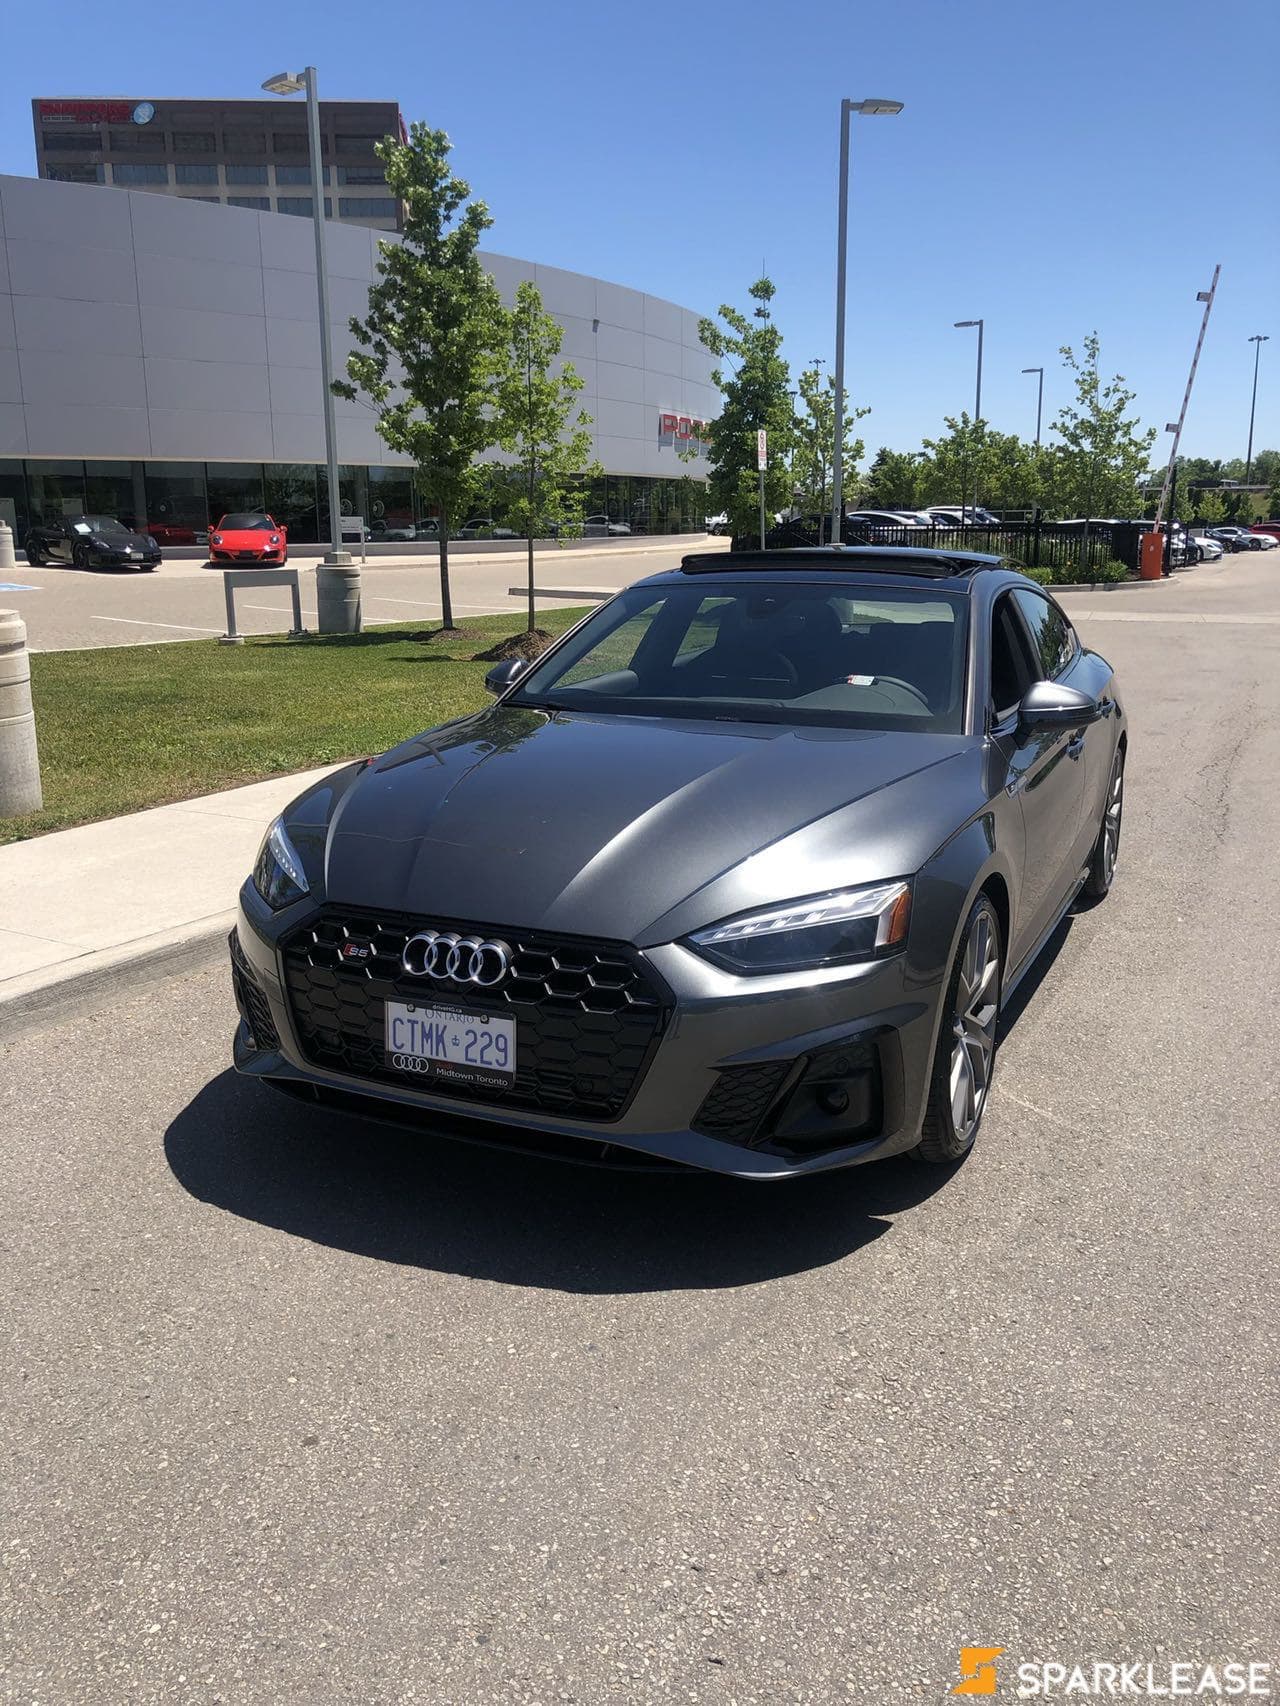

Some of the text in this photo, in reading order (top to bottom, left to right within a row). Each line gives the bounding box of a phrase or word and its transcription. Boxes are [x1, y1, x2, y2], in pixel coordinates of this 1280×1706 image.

[392, 1017, 508, 1068] CTMK 229
[436, 1067, 508, 1087] Midtown Toronto
